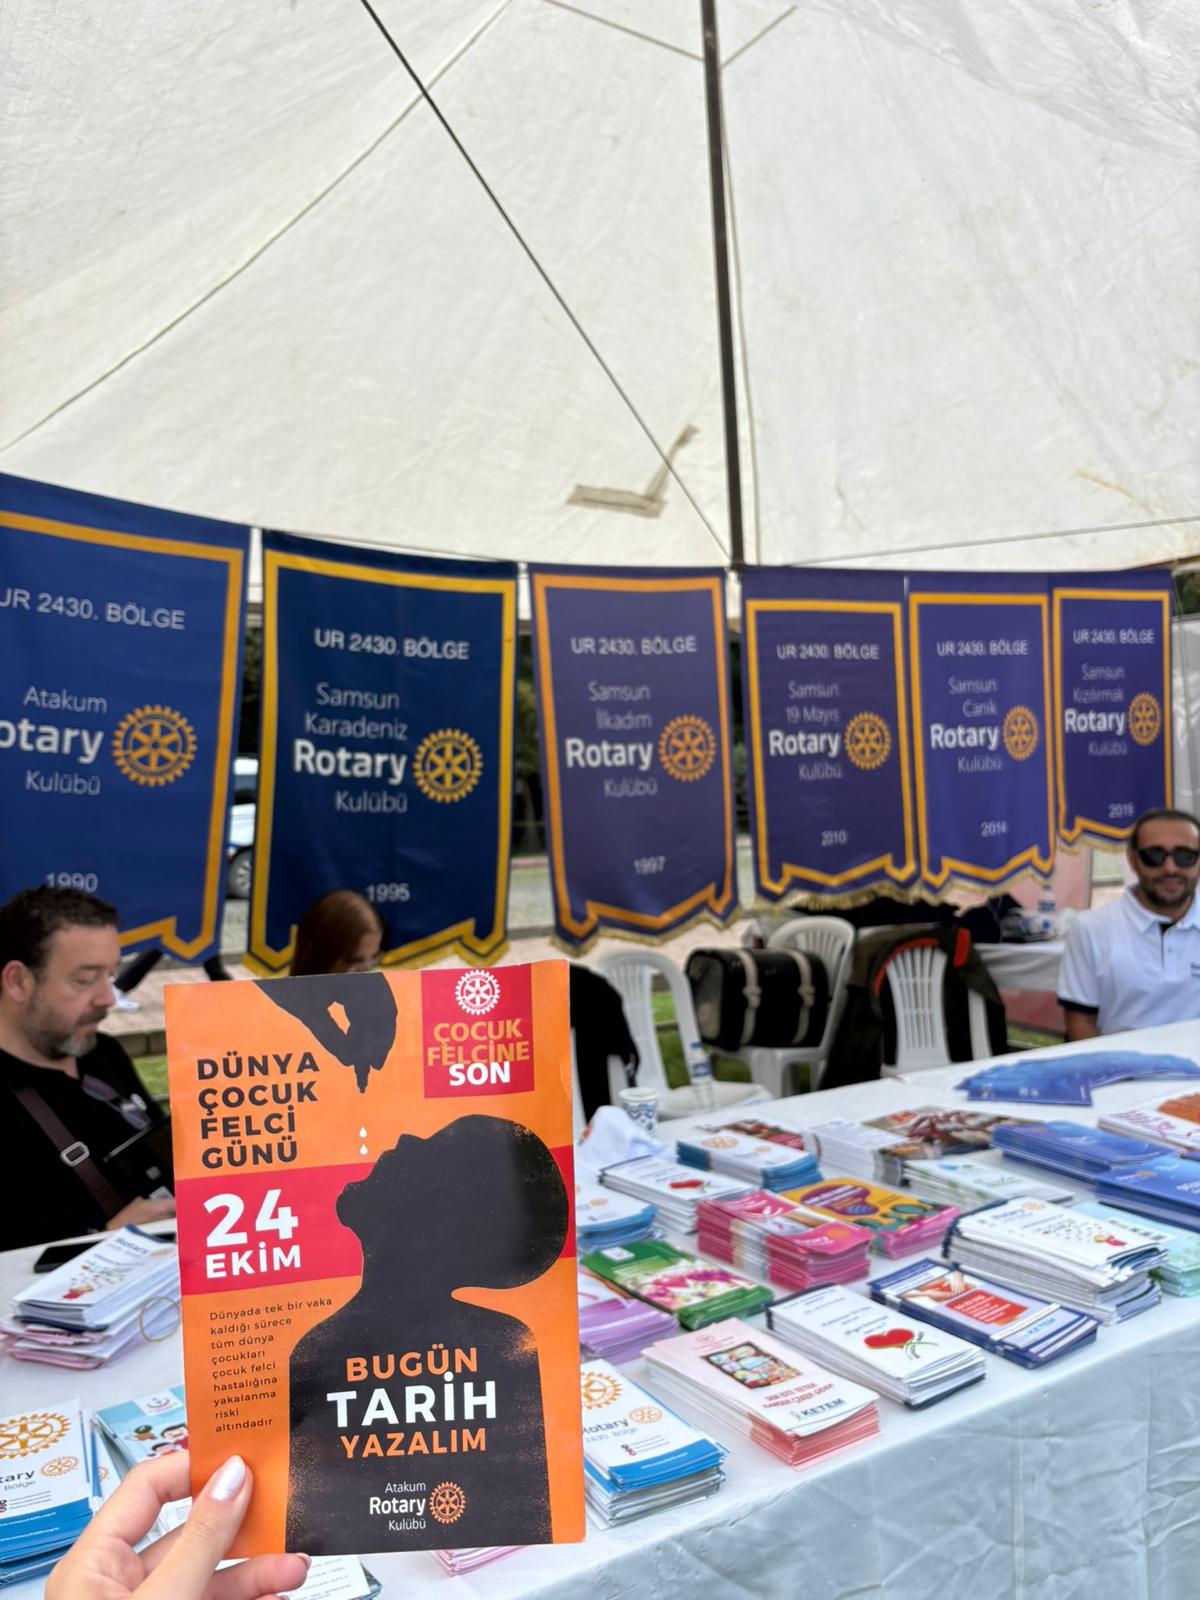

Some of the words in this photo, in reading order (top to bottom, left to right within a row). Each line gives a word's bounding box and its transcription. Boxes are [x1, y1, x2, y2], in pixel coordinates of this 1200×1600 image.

[37, 592, 99, 620] 2430.
[106, 601, 185, 630] BÖLGE
[313, 627, 345, 650] UR
[403, 636, 470, 660] BÖLGE
[570, 636, 596, 654] UR
[599, 637, 637, 655] 2430.
[640, 635, 697, 655] BÖLGE
[1072, 628, 1089, 644] UR
[776, 643, 797, 660] UR
[833, 642, 879, 660] BÖLGE
[936, 640, 955, 657] UR
[988, 639, 1029, 656] BÖLGE
[315, 682, 400, 710] Samsun
[587, 680, 651, 702] Samsun
[788, 680, 839, 699] Samsun
[948, 675, 997, 695] Samsun
[23, 685, 107, 713] Atakum
[962, 697, 998, 718] Canik
[304, 712, 408, 740] Karadeniz
[785, 705, 799, 724] 19
[1064, 707, 1125, 736] Rotary
[0, 719, 104, 764] otary
[768, 729, 840, 758] Rotary
[930, 723, 999, 751] Rotary
[293, 738, 408, 785] Rotary
[564, 737, 653, 772] Rotary
[25, 770, 102, 796] Kulübü
[603, 777, 658, 797] Kulübü
[335, 790, 408, 813] Kulübü
[821, 830, 848, 847] 2010
[633, 855, 666, 875] 1997
[44, 871, 98, 892] 1990
[365, 882, 410, 903] 1995
[433, 1018, 523, 1047] ÇOCUK
[196, 1050, 320, 1080] DÜNYA
[427, 1040, 530, 1067] FELCİNE
[448, 1060, 511, 1087] SON
[197, 1080, 319, 1115] ÇOCUK
[200, 1106, 296, 1139] FELCİ
[201, 1140, 297, 1169] GÜNÜ
[202, 1188, 299, 1248] 24
[205, 1244, 301, 1279] EKİM
[209, 1307, 261, 1321] Dünyada
[265, 1304, 283, 1314] tek
[287, 1301, 303, 1310] bir
[307, 1298, 332, 1308] vaka
[210, 1322, 250, 1335] kaldığı
[254, 1318, 292, 1330] sürece
[211, 1339, 235, 1350] tüm
[239, 1334, 274, 1346] dünya
[211, 1349, 266, 1366] çocukları
[345, 1343, 478, 1382] BUGÜN
[212, 1366, 247, 1379] çocuk
[251, 1360, 276, 1372] felci
[213, 1376, 278, 1392] hastalığına
[213, 1391, 277, 1407] yakalanma
[326, 1370, 497, 1428] TARİH
[215, 1408, 239, 1419] riski
[215, 1418, 273, 1433] altındadır
[340, 1428, 487, 1459] YAZALIM
[384, 1481, 426, 1493] Atakum
[369, 1496, 427, 1516] Rotary
[388, 1518, 427, 1531] Kulübü
